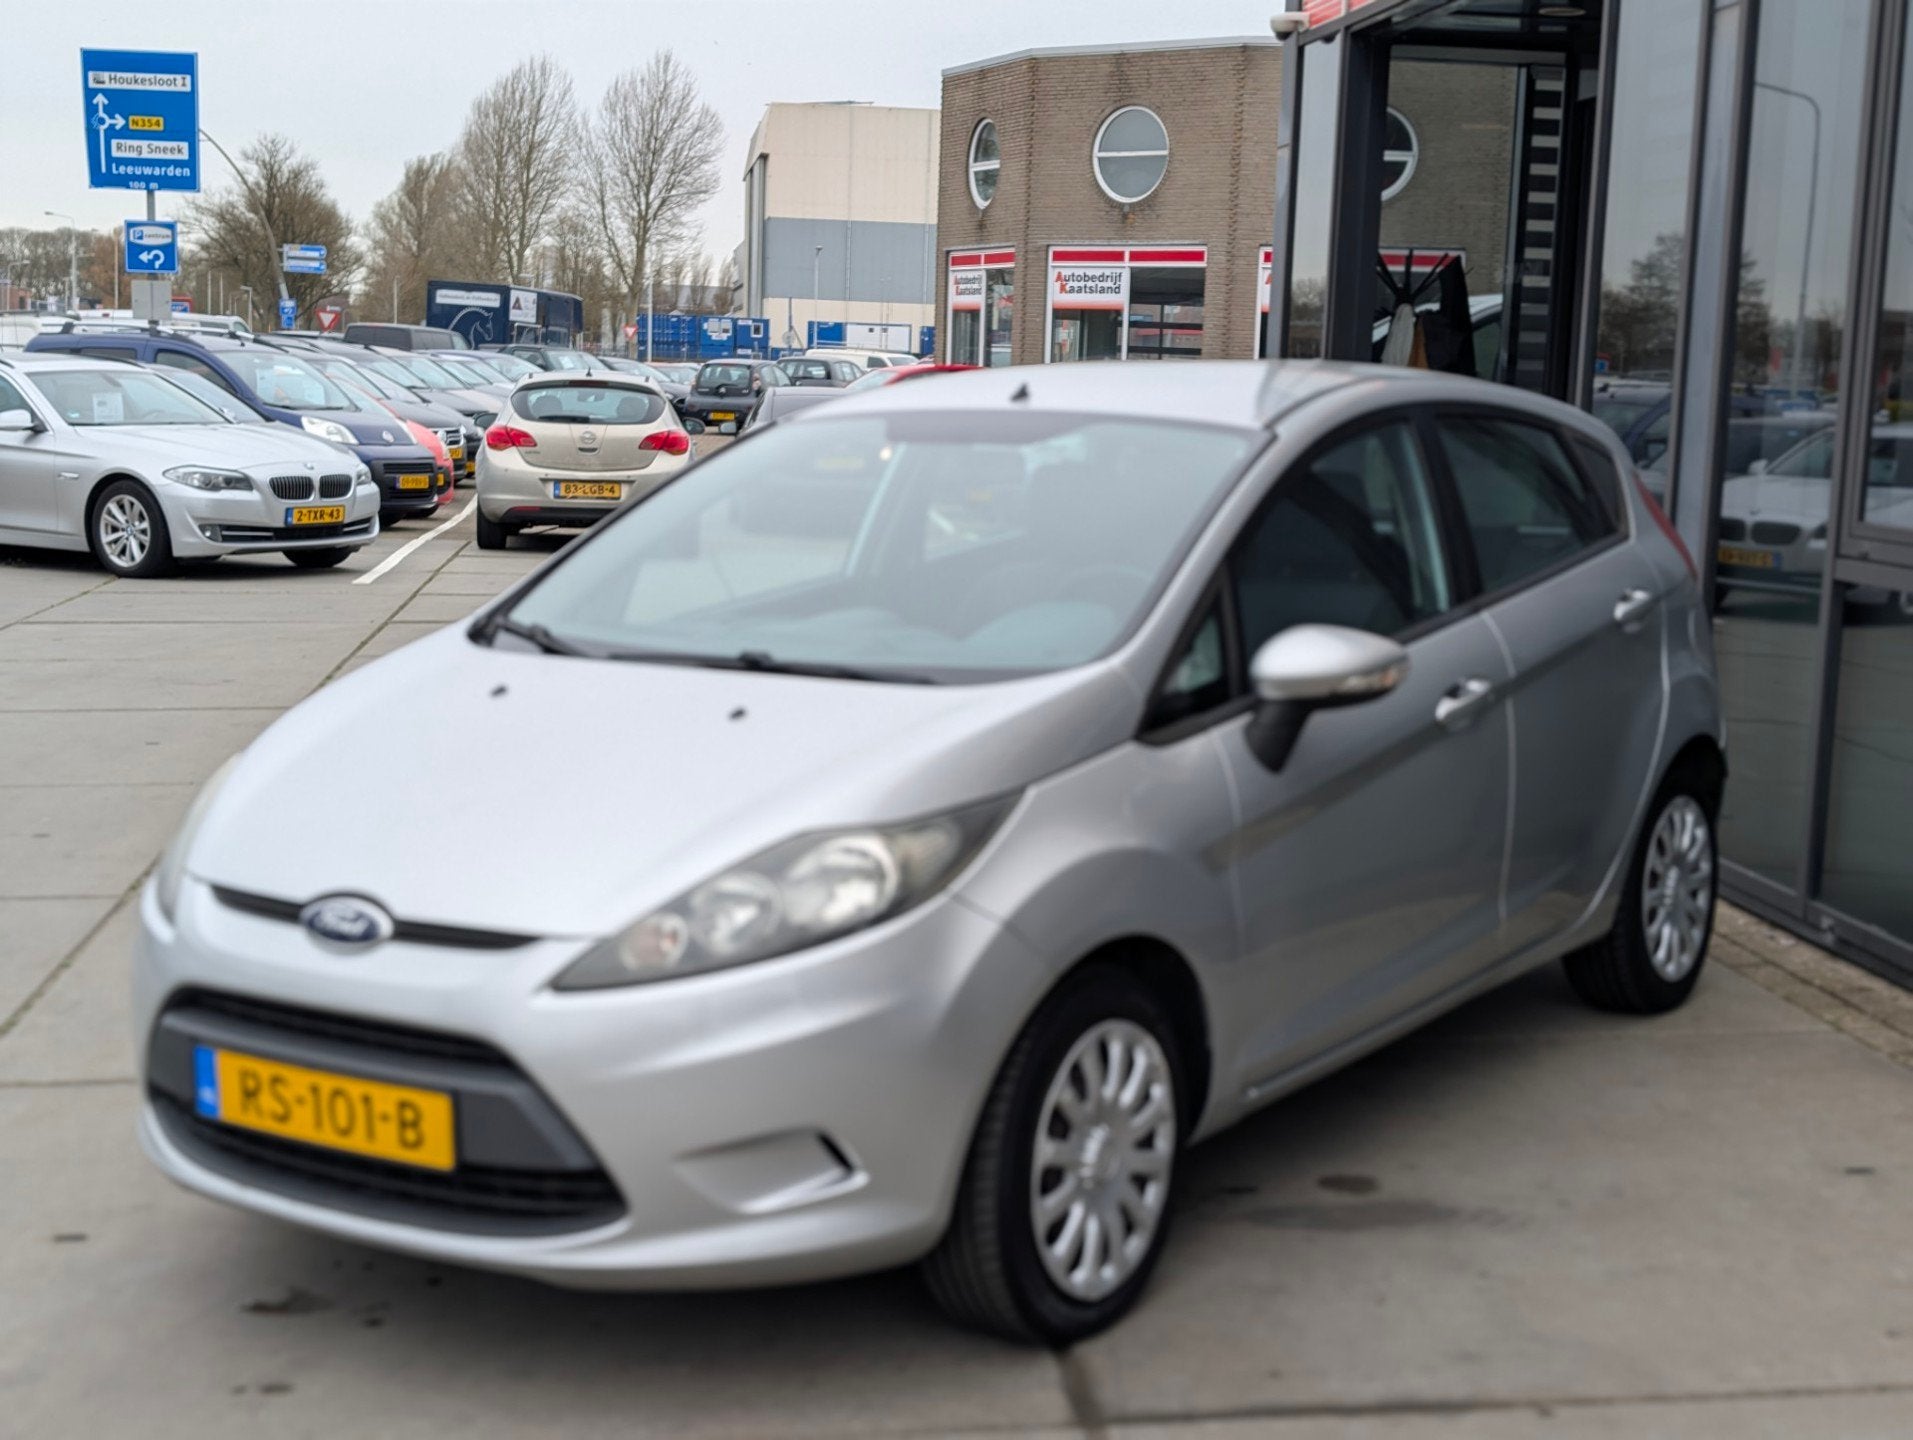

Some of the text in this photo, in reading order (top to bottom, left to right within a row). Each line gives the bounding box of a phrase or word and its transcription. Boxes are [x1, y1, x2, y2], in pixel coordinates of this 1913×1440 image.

[108, 74, 178, 87] Houkesloot
[131, 118, 161, 128] N354
[116, 142, 184, 156] Ring Sneek
[112, 162, 190, 177] Leeuwarden
[1055, 271, 1123, 285] Autobedrijf
[1059, 283, 1121, 294] Kaatsland
[296, 508, 341, 522] 2-TXR-43
[237, 1066, 425, 1150] RS-101-B
